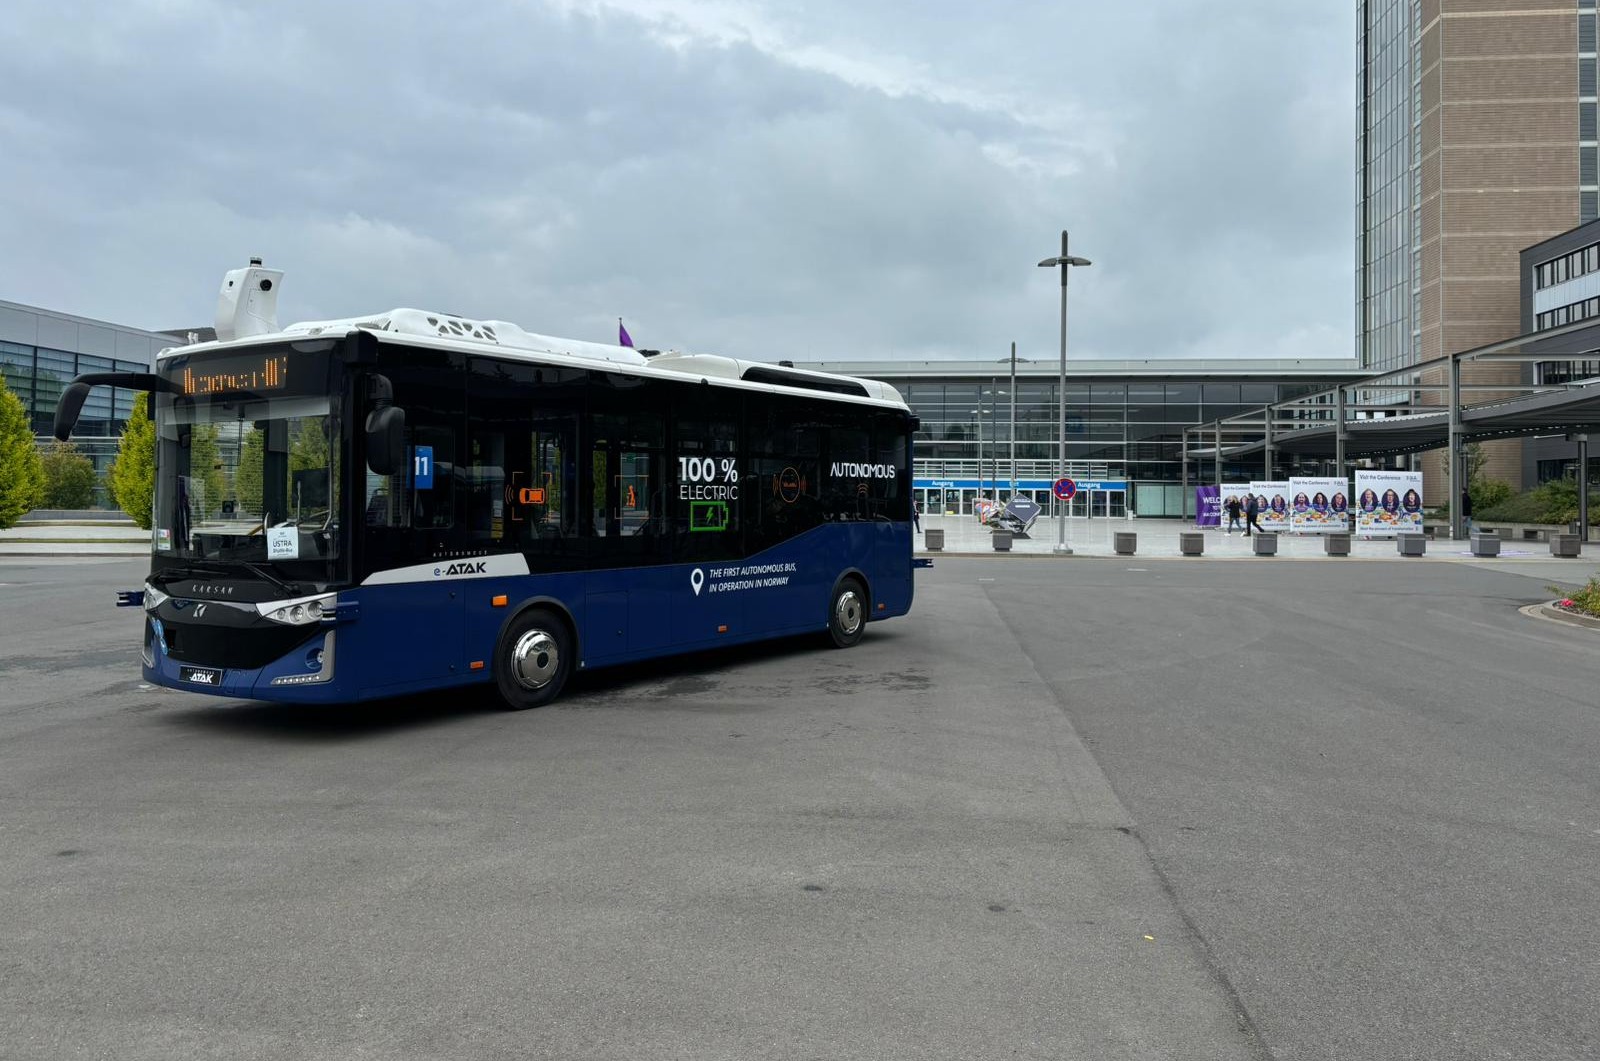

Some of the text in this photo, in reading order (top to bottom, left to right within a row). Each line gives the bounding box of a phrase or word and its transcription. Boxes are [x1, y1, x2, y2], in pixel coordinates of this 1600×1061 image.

[414, 456, 428, 476] 11
[679, 457, 738, 482] 100 %
[830, 462, 896, 479] AUTONOMOUS
[932, 480, 954, 488] Ausgang
[680, 485, 738, 500] ELECTRIC
[433, 562, 487, 577] e-ATAK
[709, 569, 722, 579] THE
[723, 567, 740, 577] FIRST
[740, 563, 784, 576] AUTONOMOUS
[709, 576, 790, 593] IN OPERATION IN NORWAY
